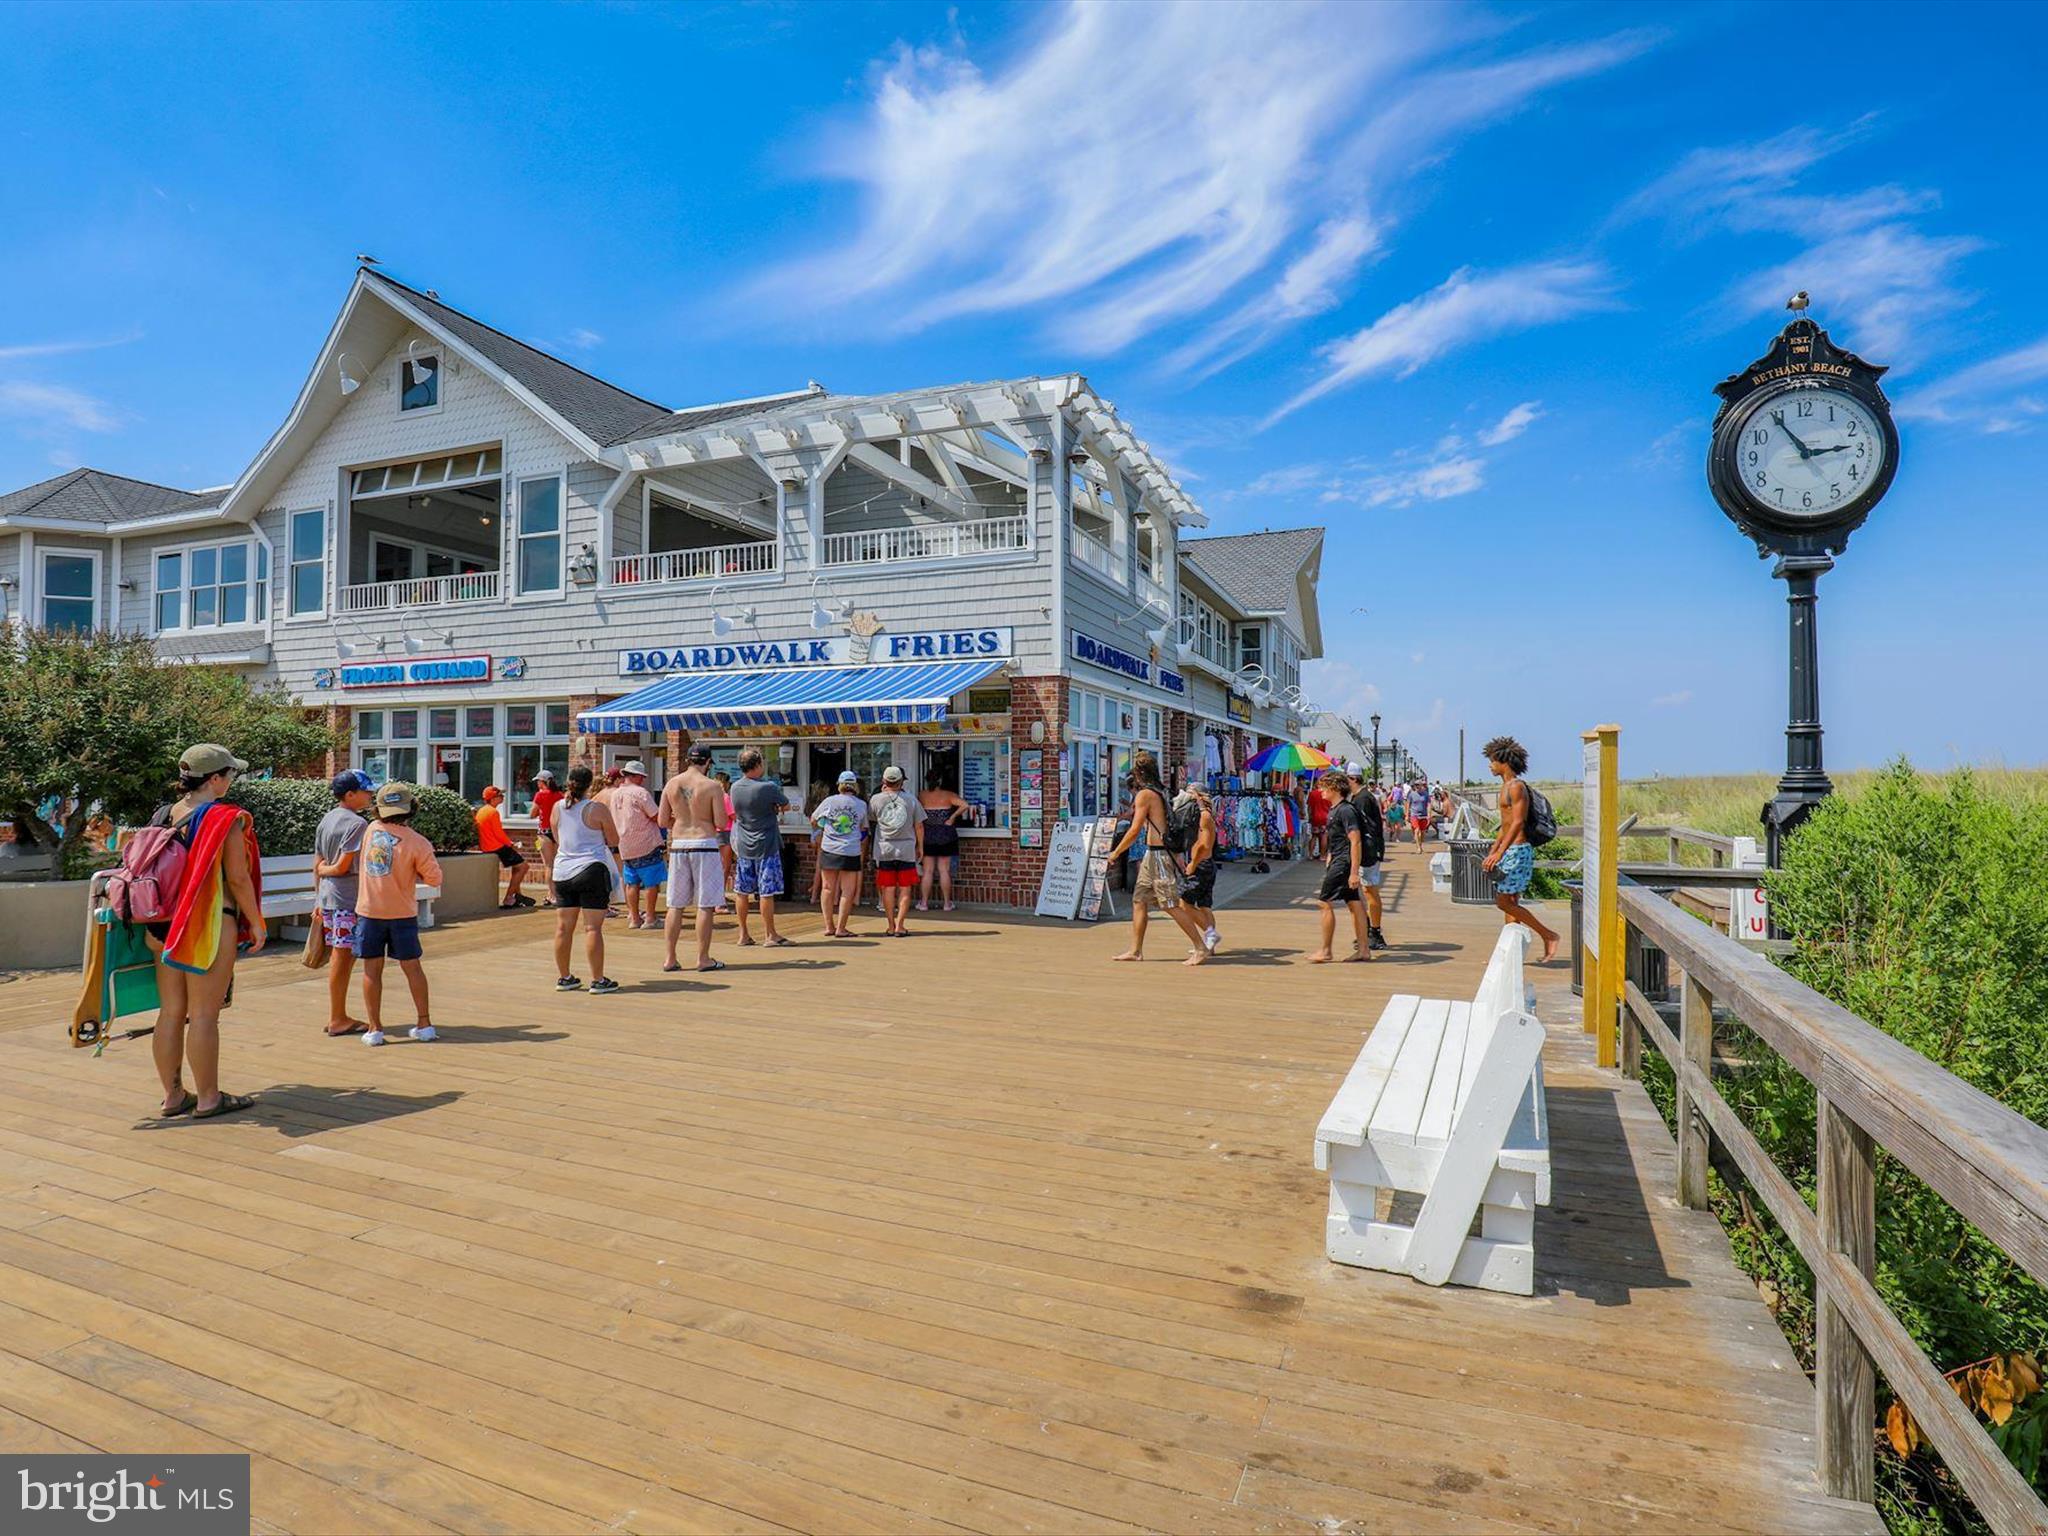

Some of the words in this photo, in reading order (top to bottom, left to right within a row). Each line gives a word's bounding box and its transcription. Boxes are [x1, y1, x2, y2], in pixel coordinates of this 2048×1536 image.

[1752, 363, 1808, 385] BETHANY
[1812, 363, 1853, 377] BEACH
[1797, 401, 1813, 417] 12
[1828, 406, 1835, 422] 1
[1753, 429, 1768, 445] 10
[1847, 421, 1857, 437] 2
[1749, 450, 1758, 467] 9
[1856, 442, 1865, 459] 3
[1756, 472, 1767, 487] 8
[1847, 464, 1858, 480] 4
[1774, 488, 1784, 503] 7
[1802, 491, 1812, 507] 6
[1830, 483, 1841, 500] 5
[626, 640, 831, 672] BOARDWALK
[888, 631, 999, 658] FRIES
[341, 665, 405, 684] FROZEN
[410, 660, 487, 681] CUSTARD
[1077, 635, 1149, 680] BOARDWALK
[1160, 670, 1184, 693] FRIES
[1056, 843, 1081, 853] Coffee
